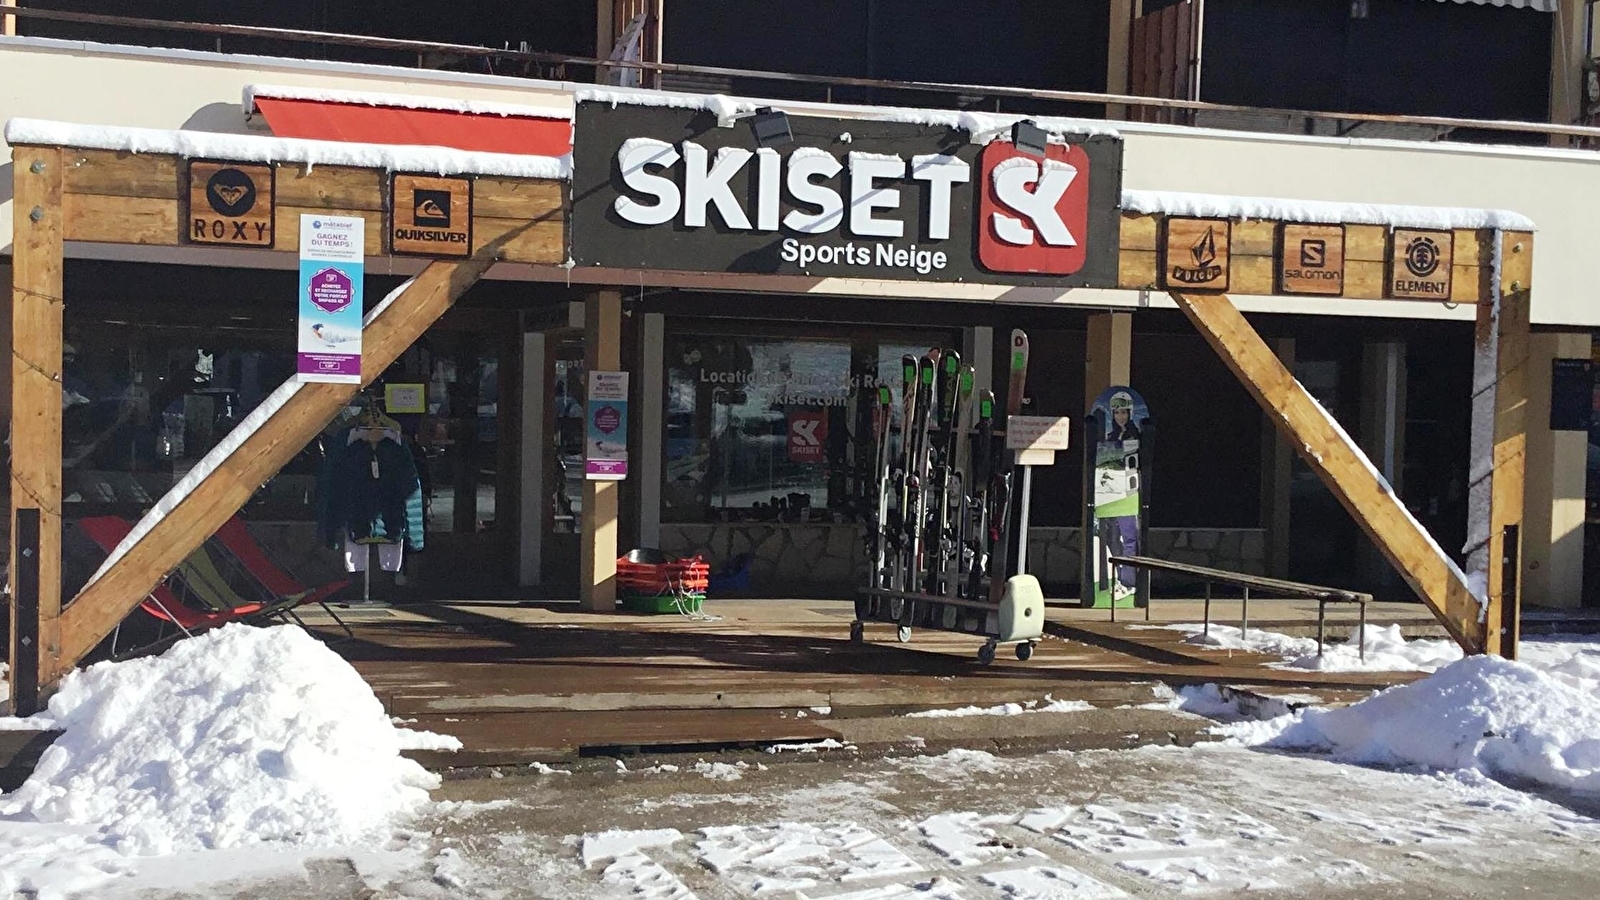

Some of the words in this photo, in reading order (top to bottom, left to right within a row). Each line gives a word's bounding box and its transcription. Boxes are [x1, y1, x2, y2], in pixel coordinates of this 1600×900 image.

[614, 137, 970, 240] SKISET
[992, 156, 1079, 246] SK
[194, 218, 267, 241] ROXY
[395, 228, 467, 243] QUIKSILVER
[780, 238, 872, 268] Sports
[875, 243, 948, 273] Neige
[1395, 280, 1446, 294] ELEMENT
[700, 368, 765, 385] Locatio
[791, 446, 821, 455] SKISET
